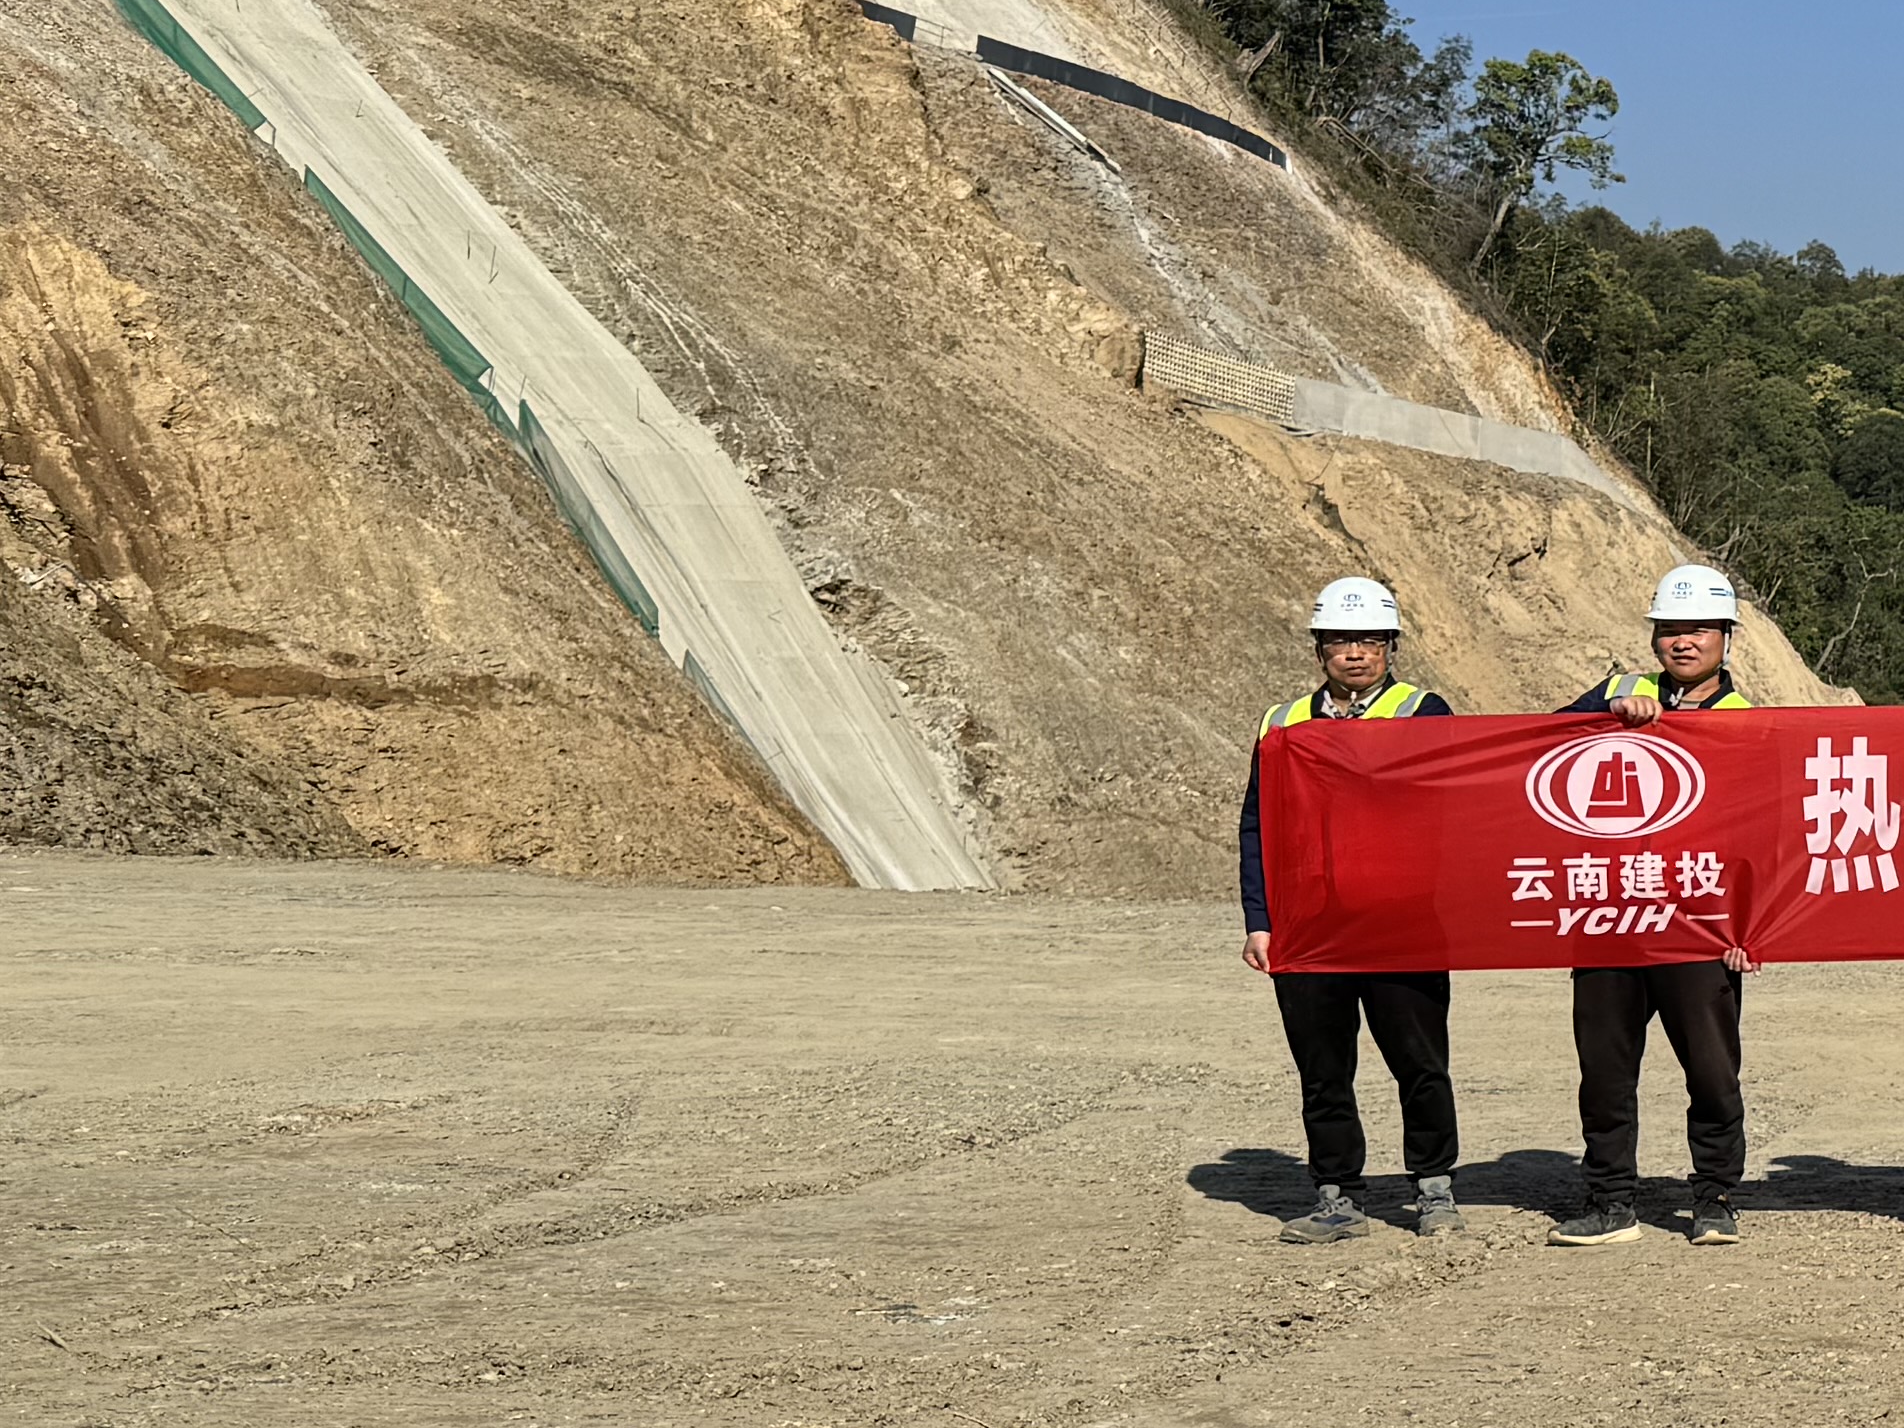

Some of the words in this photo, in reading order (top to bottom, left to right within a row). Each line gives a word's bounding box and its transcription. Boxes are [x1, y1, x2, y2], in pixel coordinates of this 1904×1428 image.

[1506, 850, 1727, 902] 云南建投
[1556, 903, 1678, 936] YCIH
